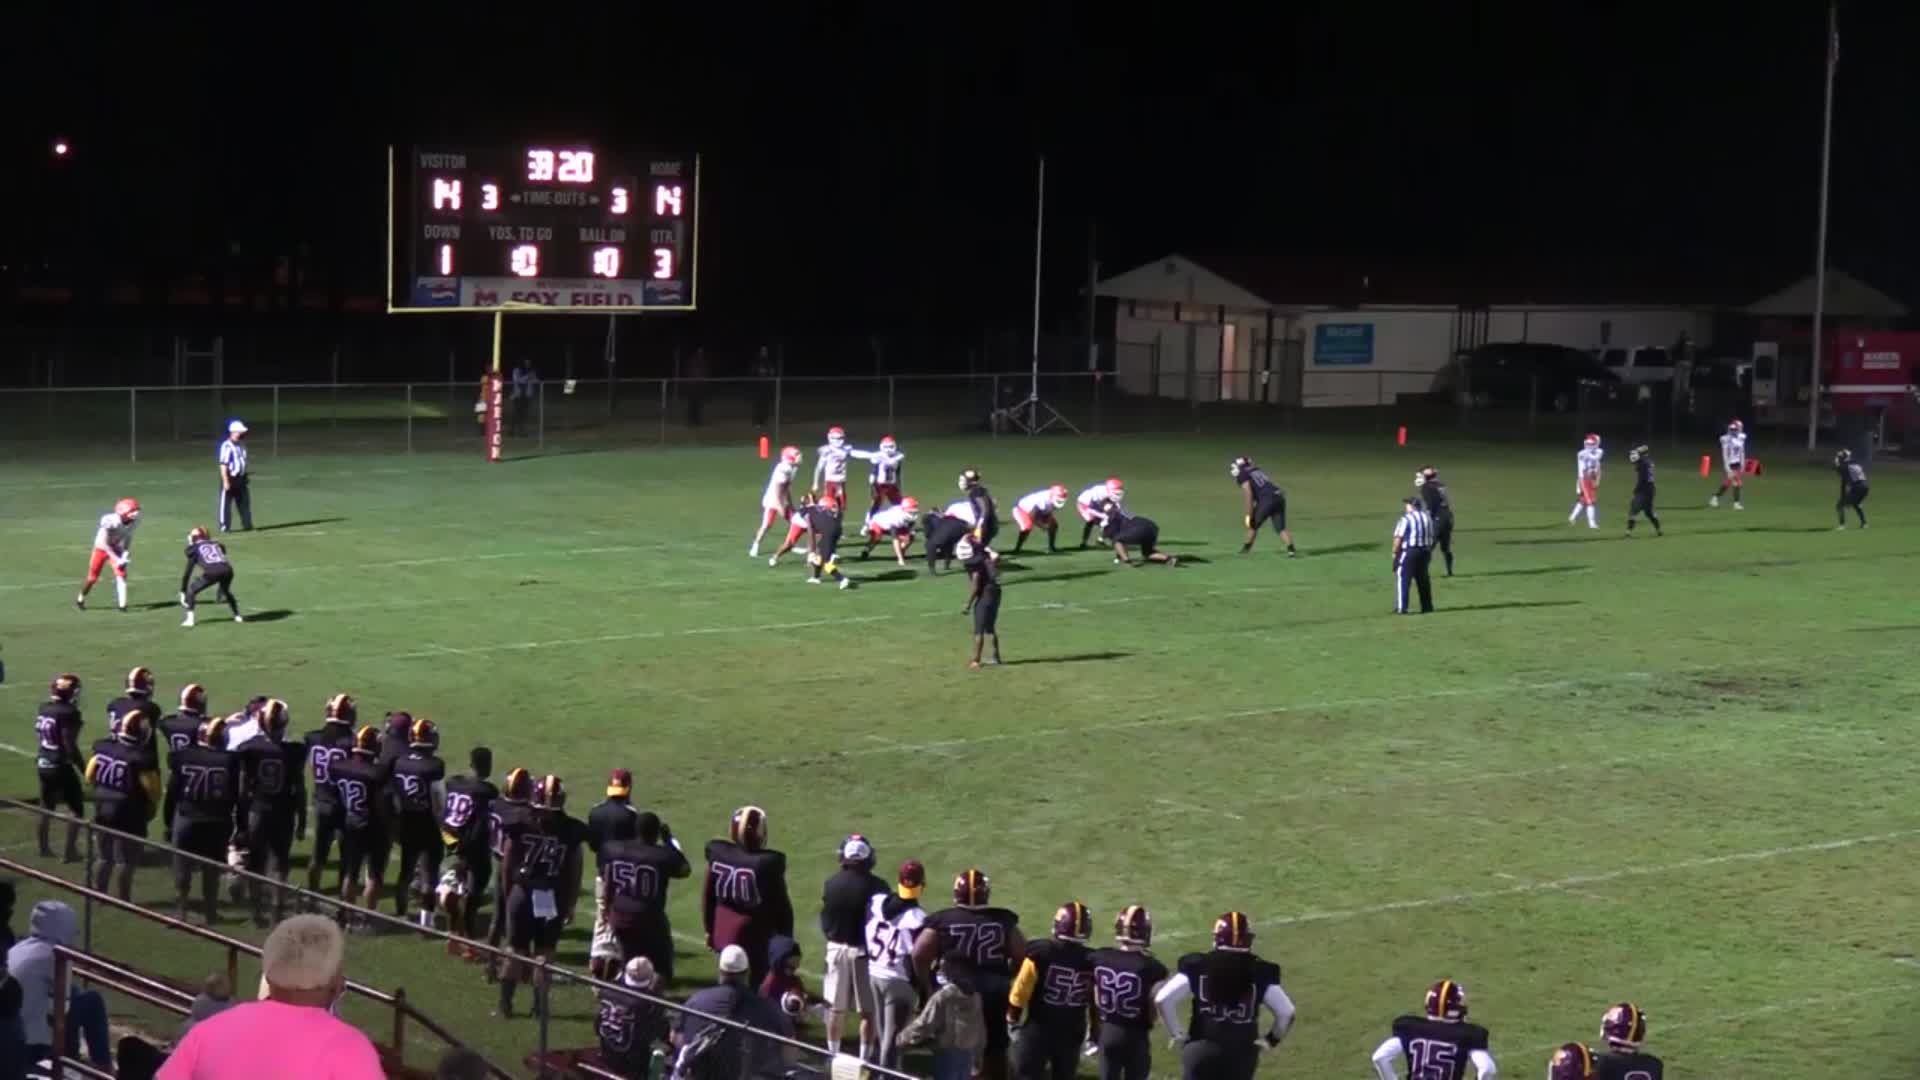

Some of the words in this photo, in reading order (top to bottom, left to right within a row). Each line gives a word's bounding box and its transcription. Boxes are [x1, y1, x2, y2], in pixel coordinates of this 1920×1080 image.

[419, 152, 467, 169] VISITOR
[482, 184, 498, 210] 3
[611, 188, 628, 214] 3
[424, 225, 460, 239] DOWN
[519, 226, 535, 240] TO
[536, 227, 552, 240] GO
[441, 245, 451, 275] 1
[653, 248, 672, 279] 3
[612, 860, 659, 897] 50
[711, 861, 762, 905] 70
[869, 920, 900, 967] 54
[949, 921, 1006, 966] 72
[1094, 965, 1142, 1019] 62
[1409, 1038, 1457, 1080] 15
